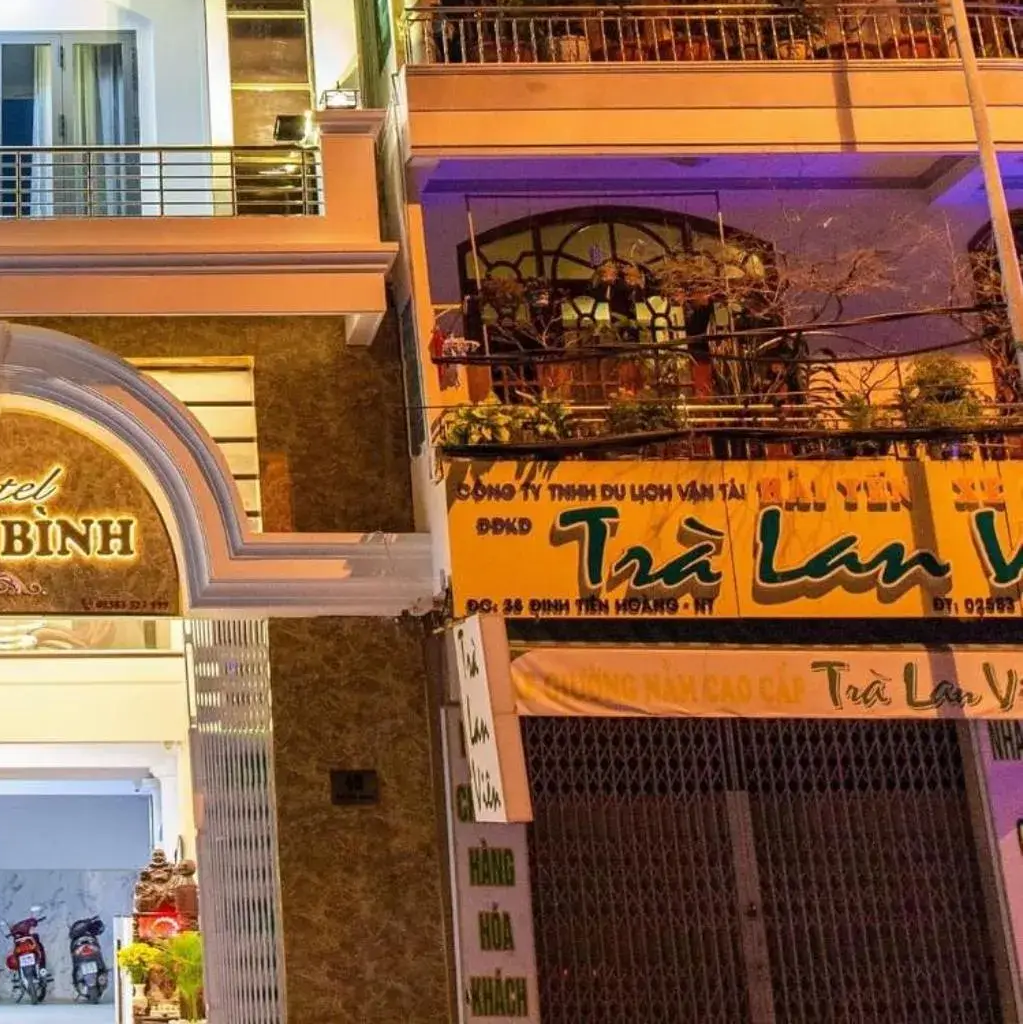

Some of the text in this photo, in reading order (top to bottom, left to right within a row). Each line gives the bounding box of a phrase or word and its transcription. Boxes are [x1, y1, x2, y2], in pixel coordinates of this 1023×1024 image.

[455, 479, 515, 502] CÔNG
[520, 481, 541, 502] TY
[548, 483, 597, 502] TNHH
[600, 484, 625, 501] DU
[630, 483, 673, 505] LỊCH
[678, 479, 714, 504] VẬN
[0, 506, 136, 558] BÌNH
[557, 506, 726, 590] Trà
[757, 506, 952, 589] Lan
[575, 593, 610, 614] TIÊN
[614, 593, 679, 614] HOÀNG
[693, 597, 715, 614] NT
[811, 660, 892, 710] Trà
[903, 660, 983, 711] Lan
